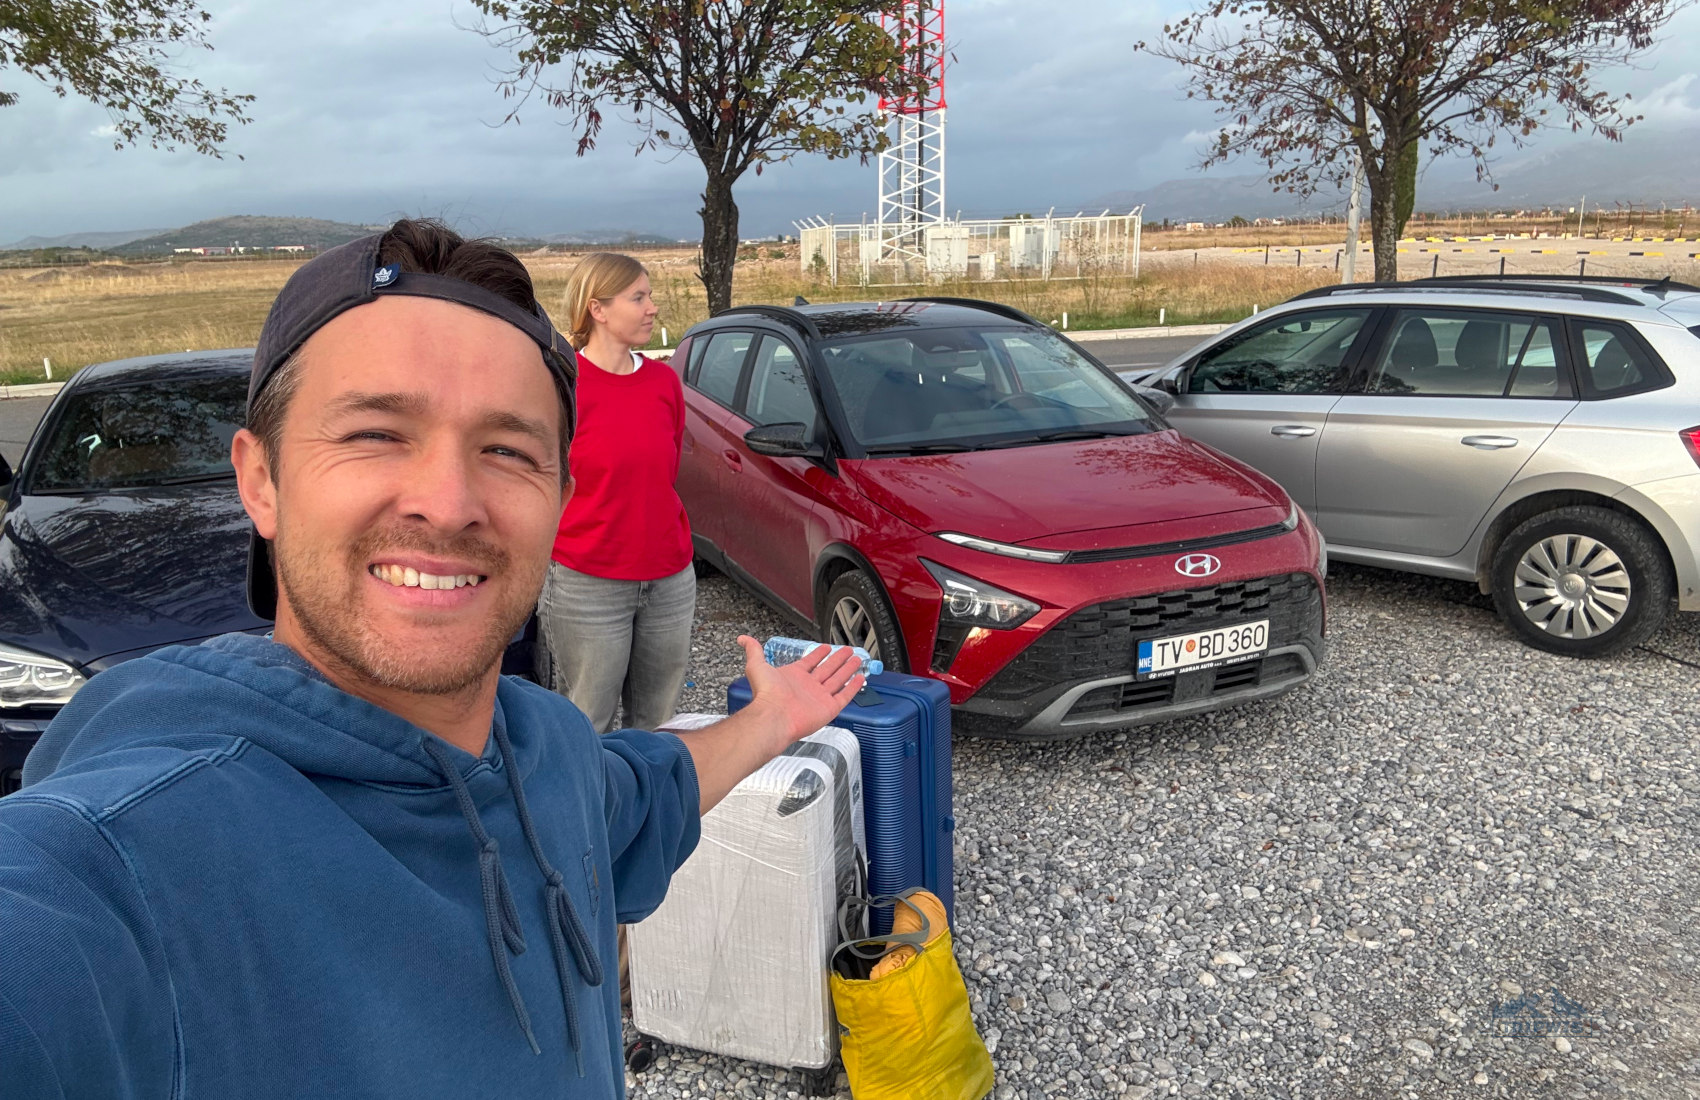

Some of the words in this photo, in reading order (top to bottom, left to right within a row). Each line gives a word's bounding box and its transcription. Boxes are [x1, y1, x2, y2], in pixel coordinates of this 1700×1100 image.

[1157, 639, 1183, 666] TV
[1138, 657, 1152, 669] MNE
[1200, 662, 1214, 670] AUTO
